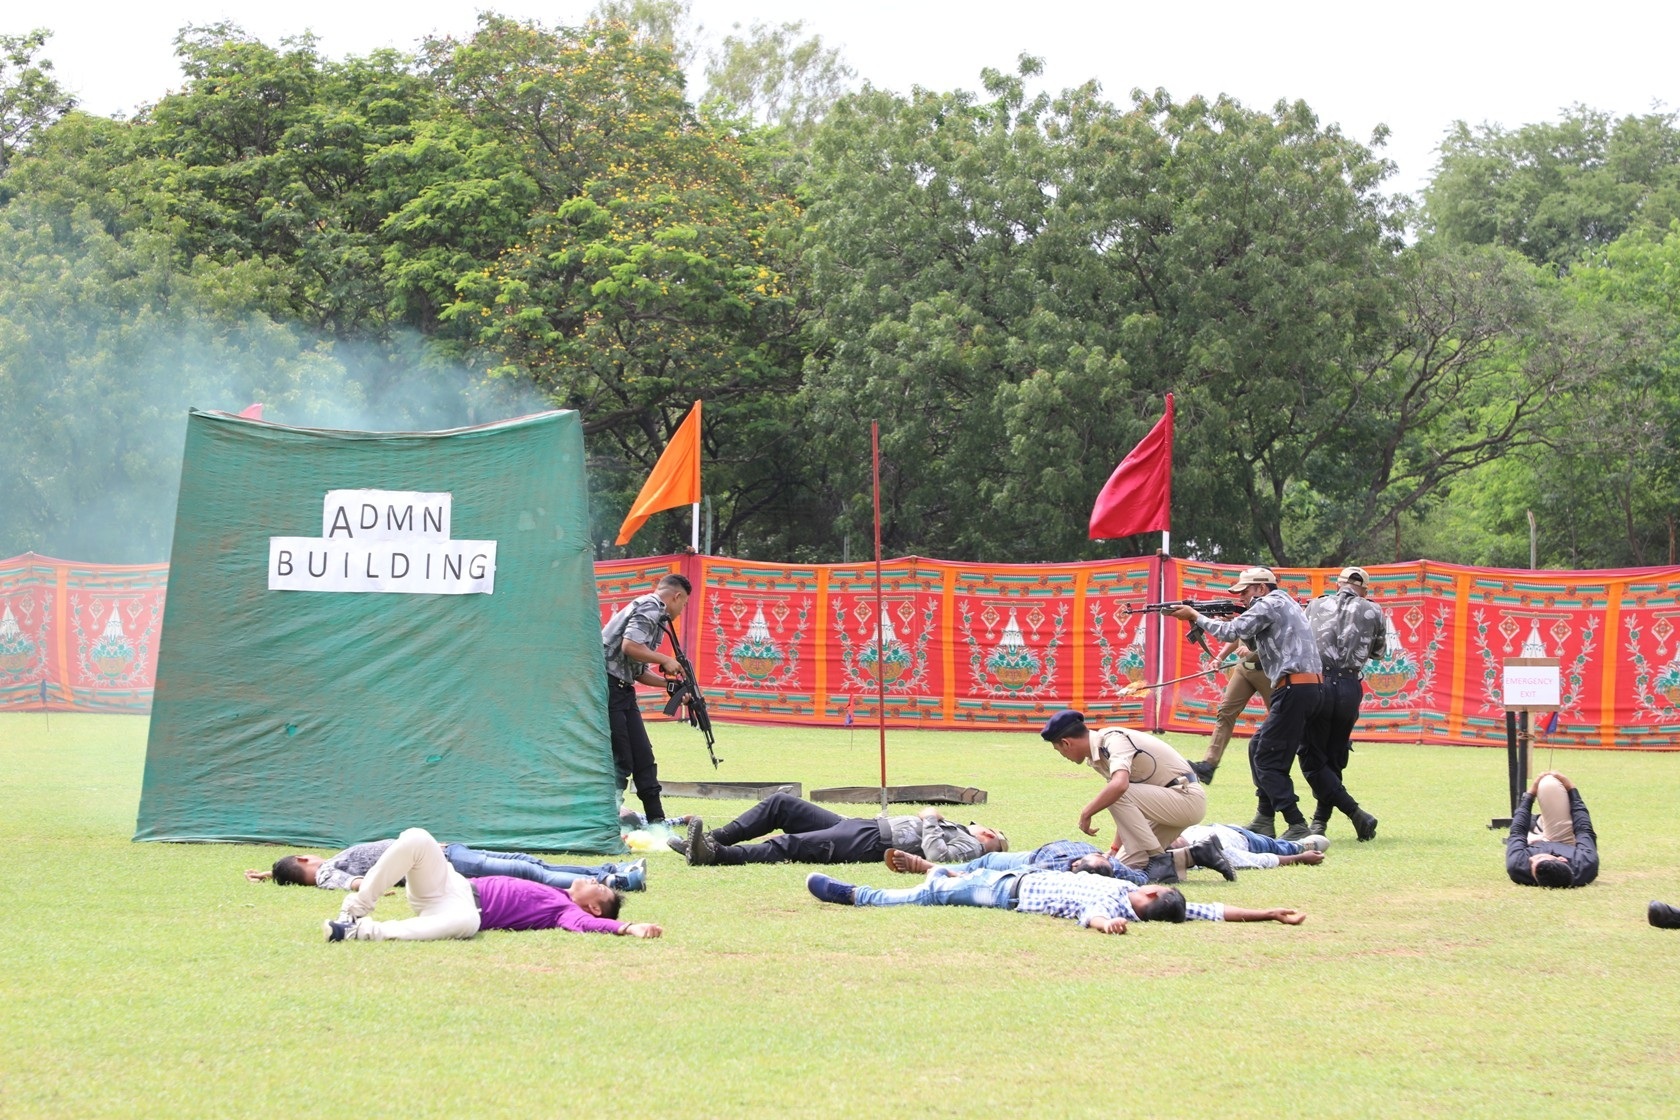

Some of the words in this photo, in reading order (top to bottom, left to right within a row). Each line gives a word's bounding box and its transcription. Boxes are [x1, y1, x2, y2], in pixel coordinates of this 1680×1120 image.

[329, 503, 443, 538] ADMN
[277, 550, 488, 580] BUILDING
[1505, 677, 1553, 685] EMERGENCY
[1520, 690, 1537, 698] EXIT
